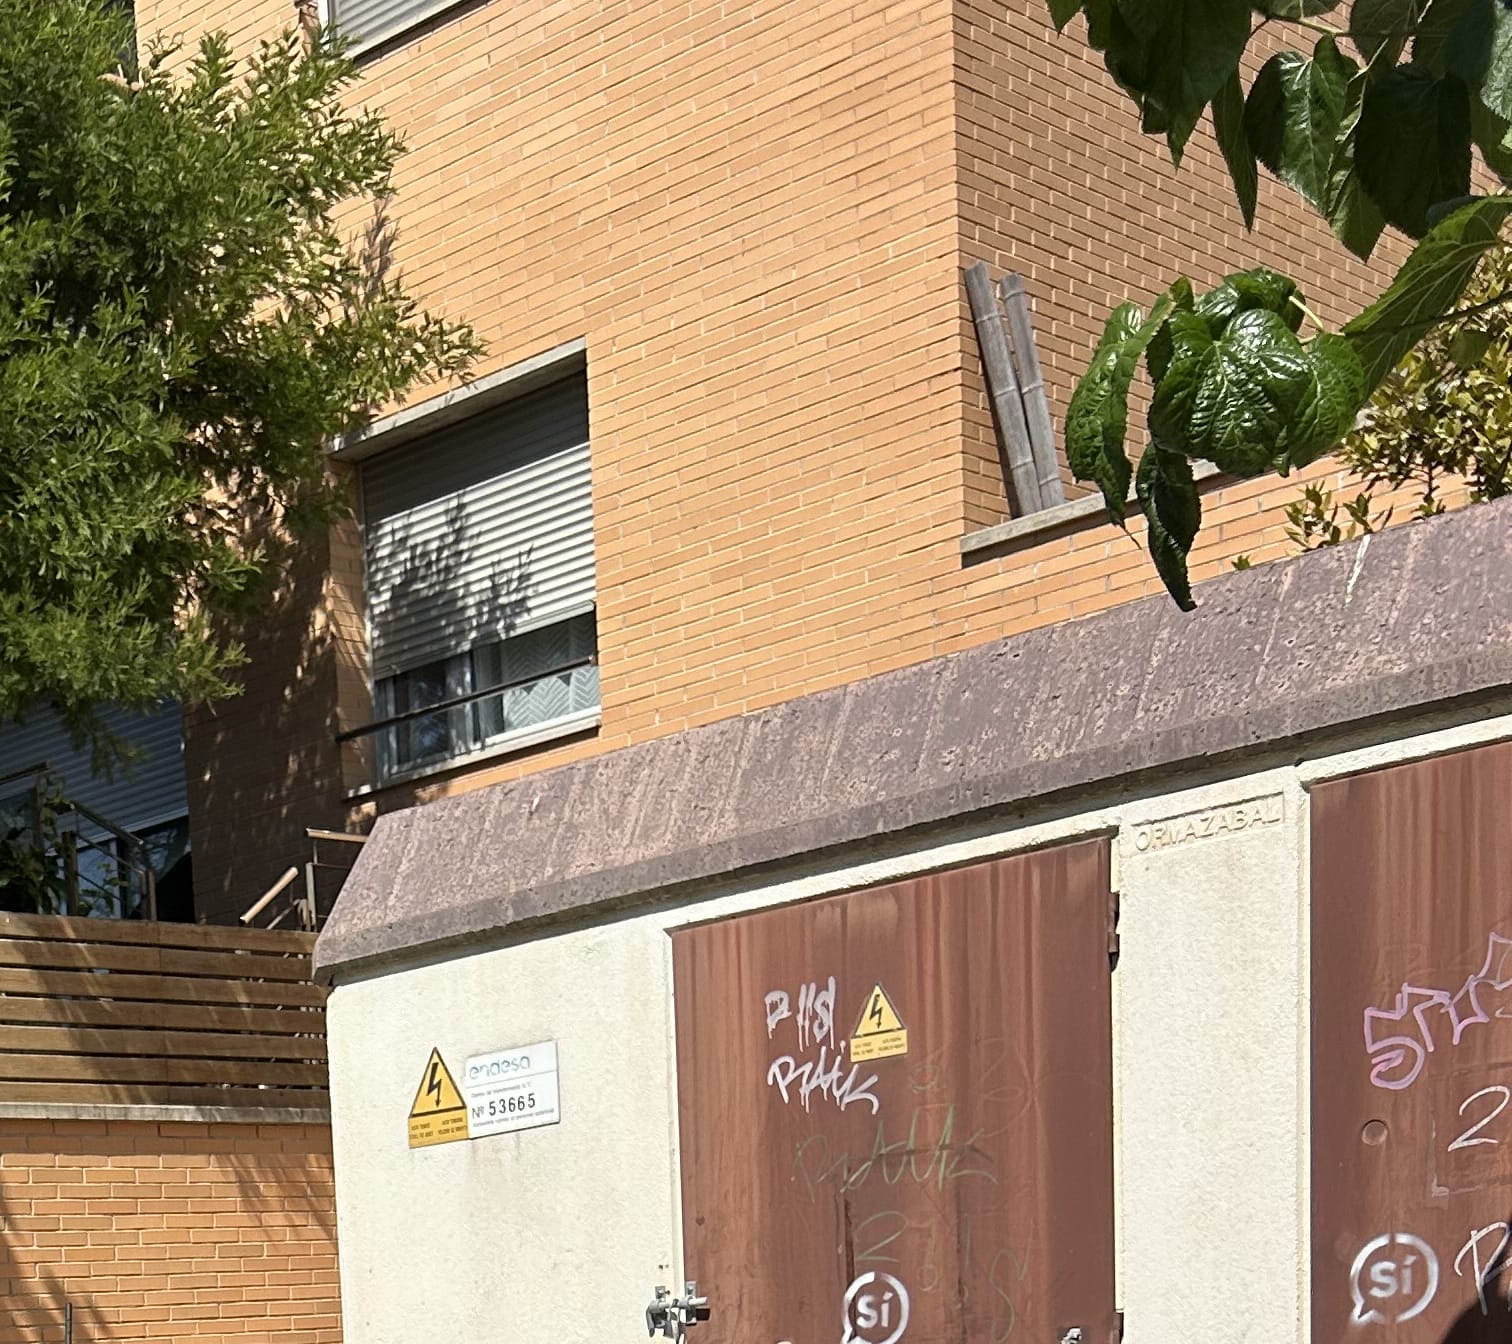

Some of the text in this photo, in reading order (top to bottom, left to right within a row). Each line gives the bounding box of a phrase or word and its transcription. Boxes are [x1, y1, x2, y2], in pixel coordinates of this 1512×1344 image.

[1136, 802, 1281, 851] ORMAZABAL
[469, 1056, 531, 1080] endesa
[488, 1093, 536, 1117] 53665
